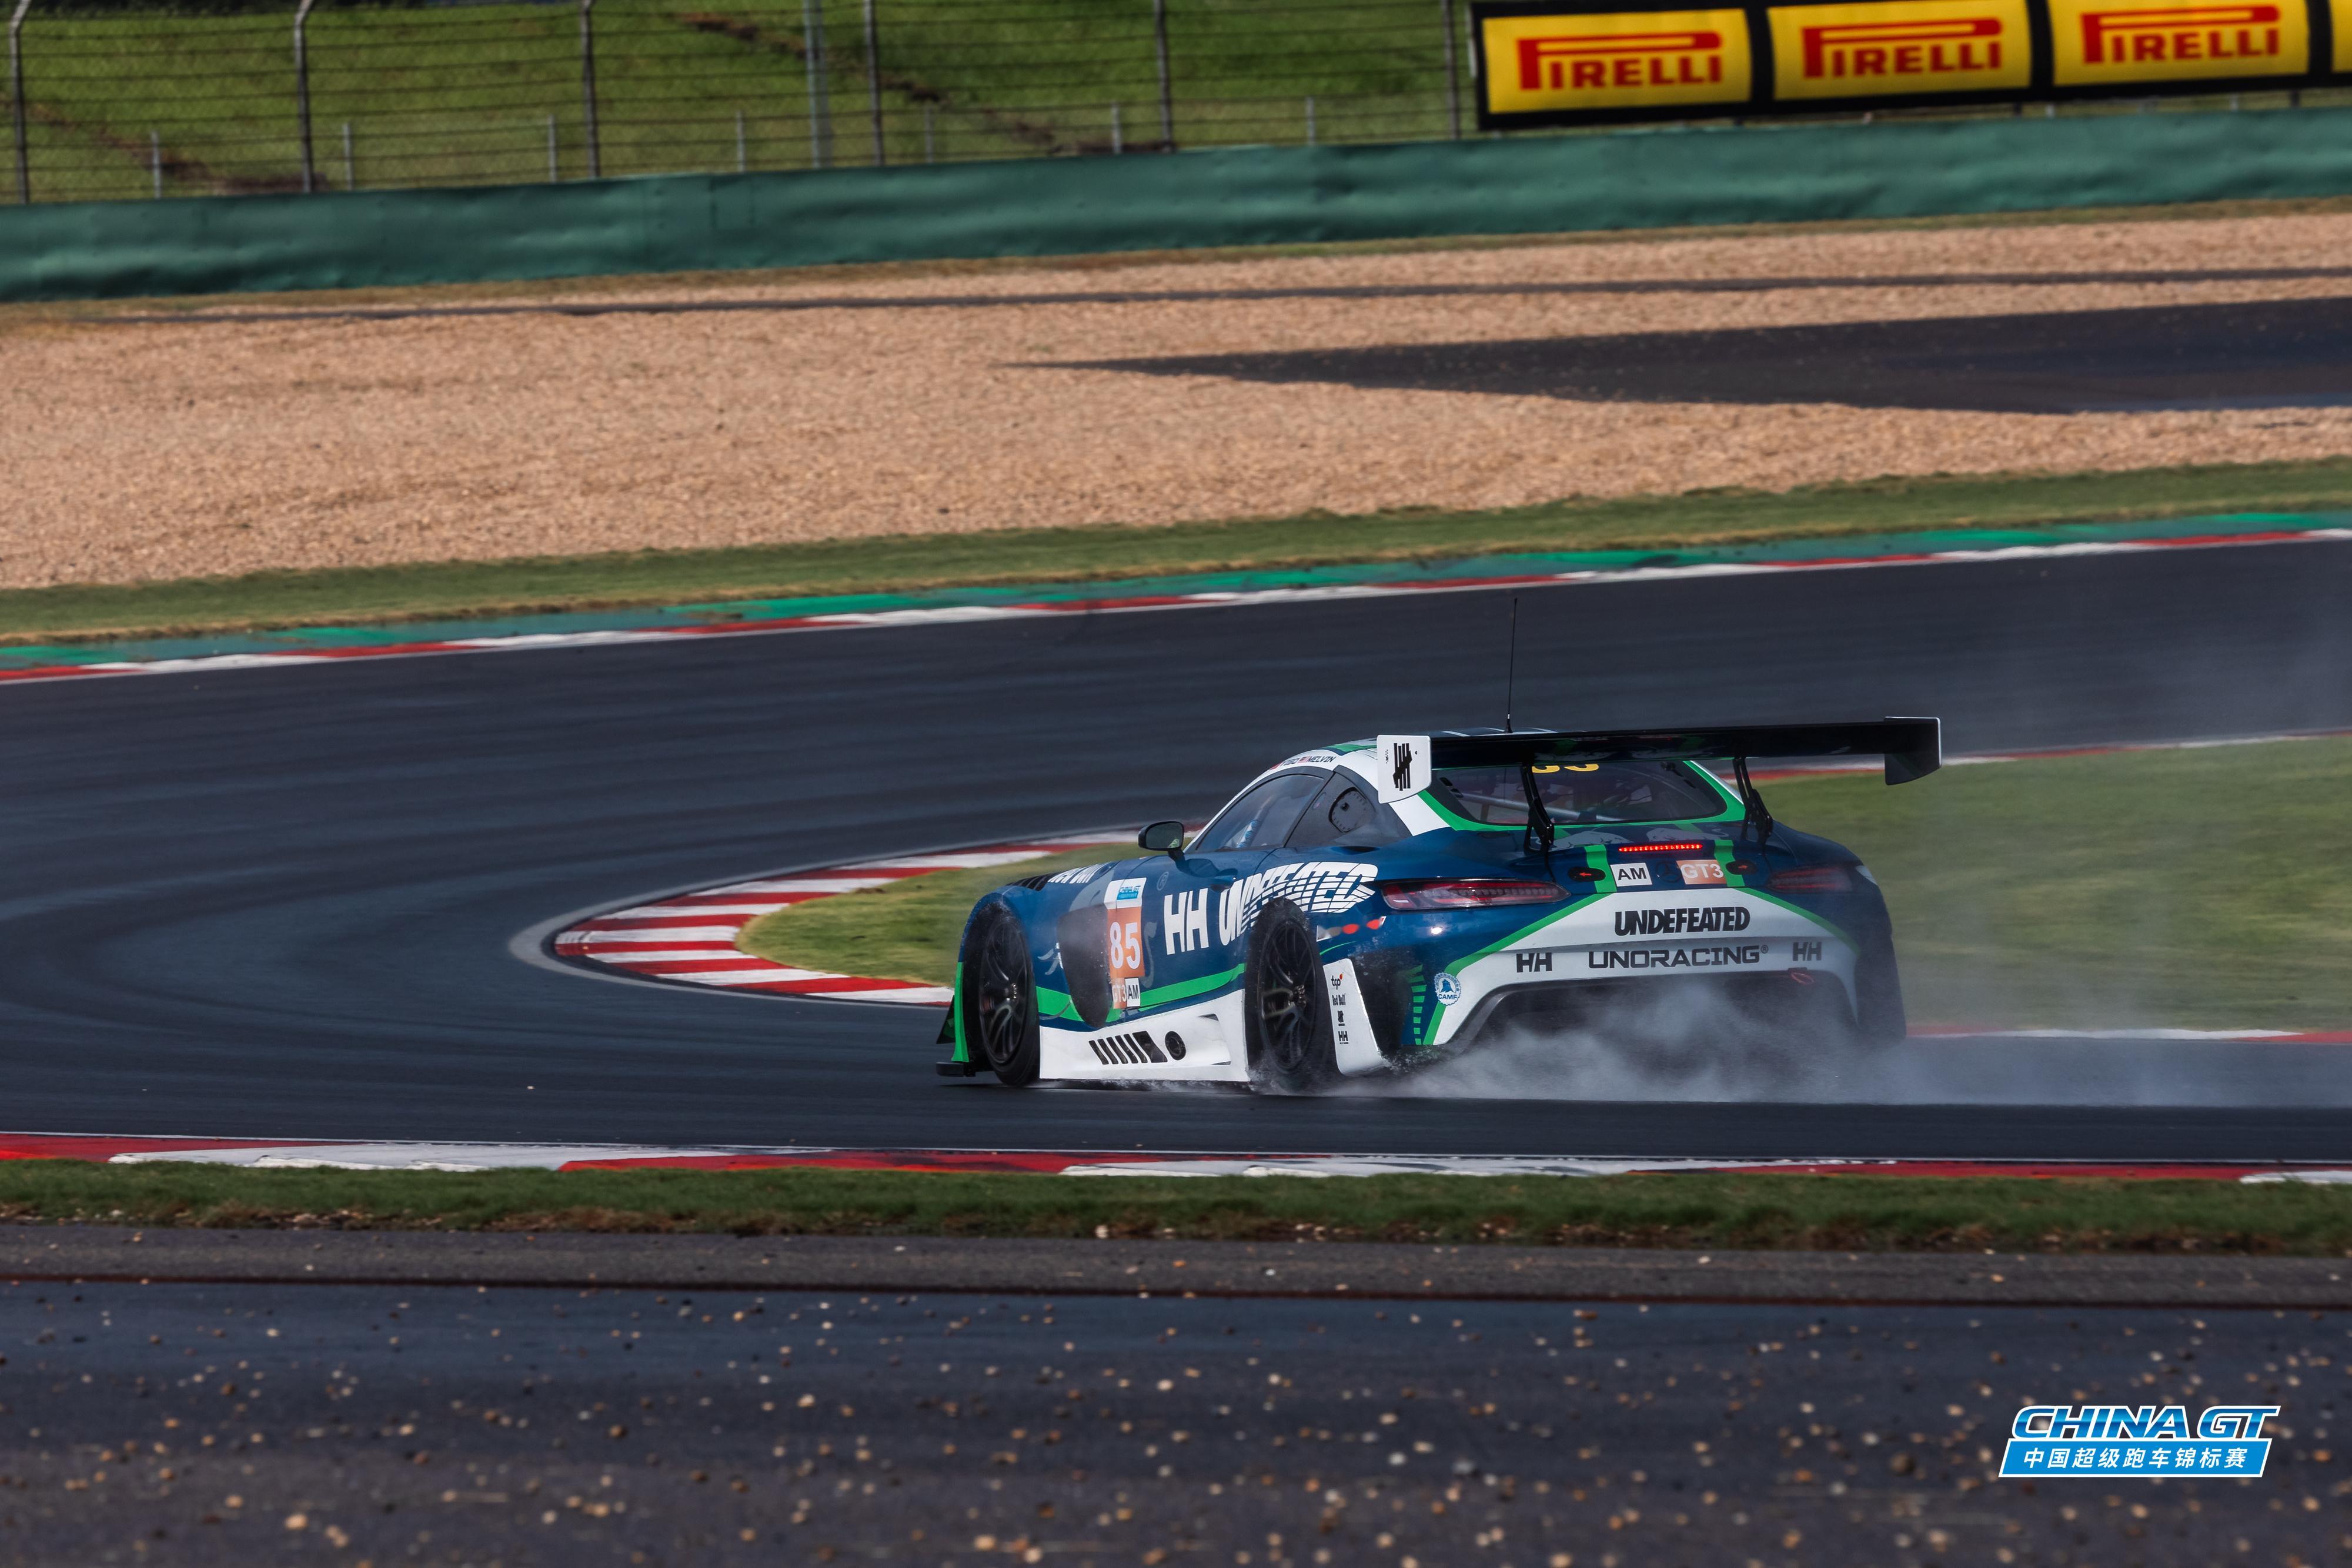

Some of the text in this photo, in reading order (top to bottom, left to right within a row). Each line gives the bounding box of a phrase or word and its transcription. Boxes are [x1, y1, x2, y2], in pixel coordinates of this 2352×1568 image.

[1802, 18, 2003, 79] PIRELLI
[2082, 6, 2279, 64] PIRELLI
[1517, 31, 1722, 91] PIRELLI
[1618, 863, 1724, 881] AM GT3
[1164, 888, 1210, 955] HH
[1614, 906, 1750, 937] UNDEFEATED
[1110, 921, 1141, 969] 85
[1516, 952, 1553, 973] HH
[1792, 942, 1822, 961] HH
[1111, 984, 1139, 1003] GT3 AM
[1338, 1031, 1349, 1042] HH
